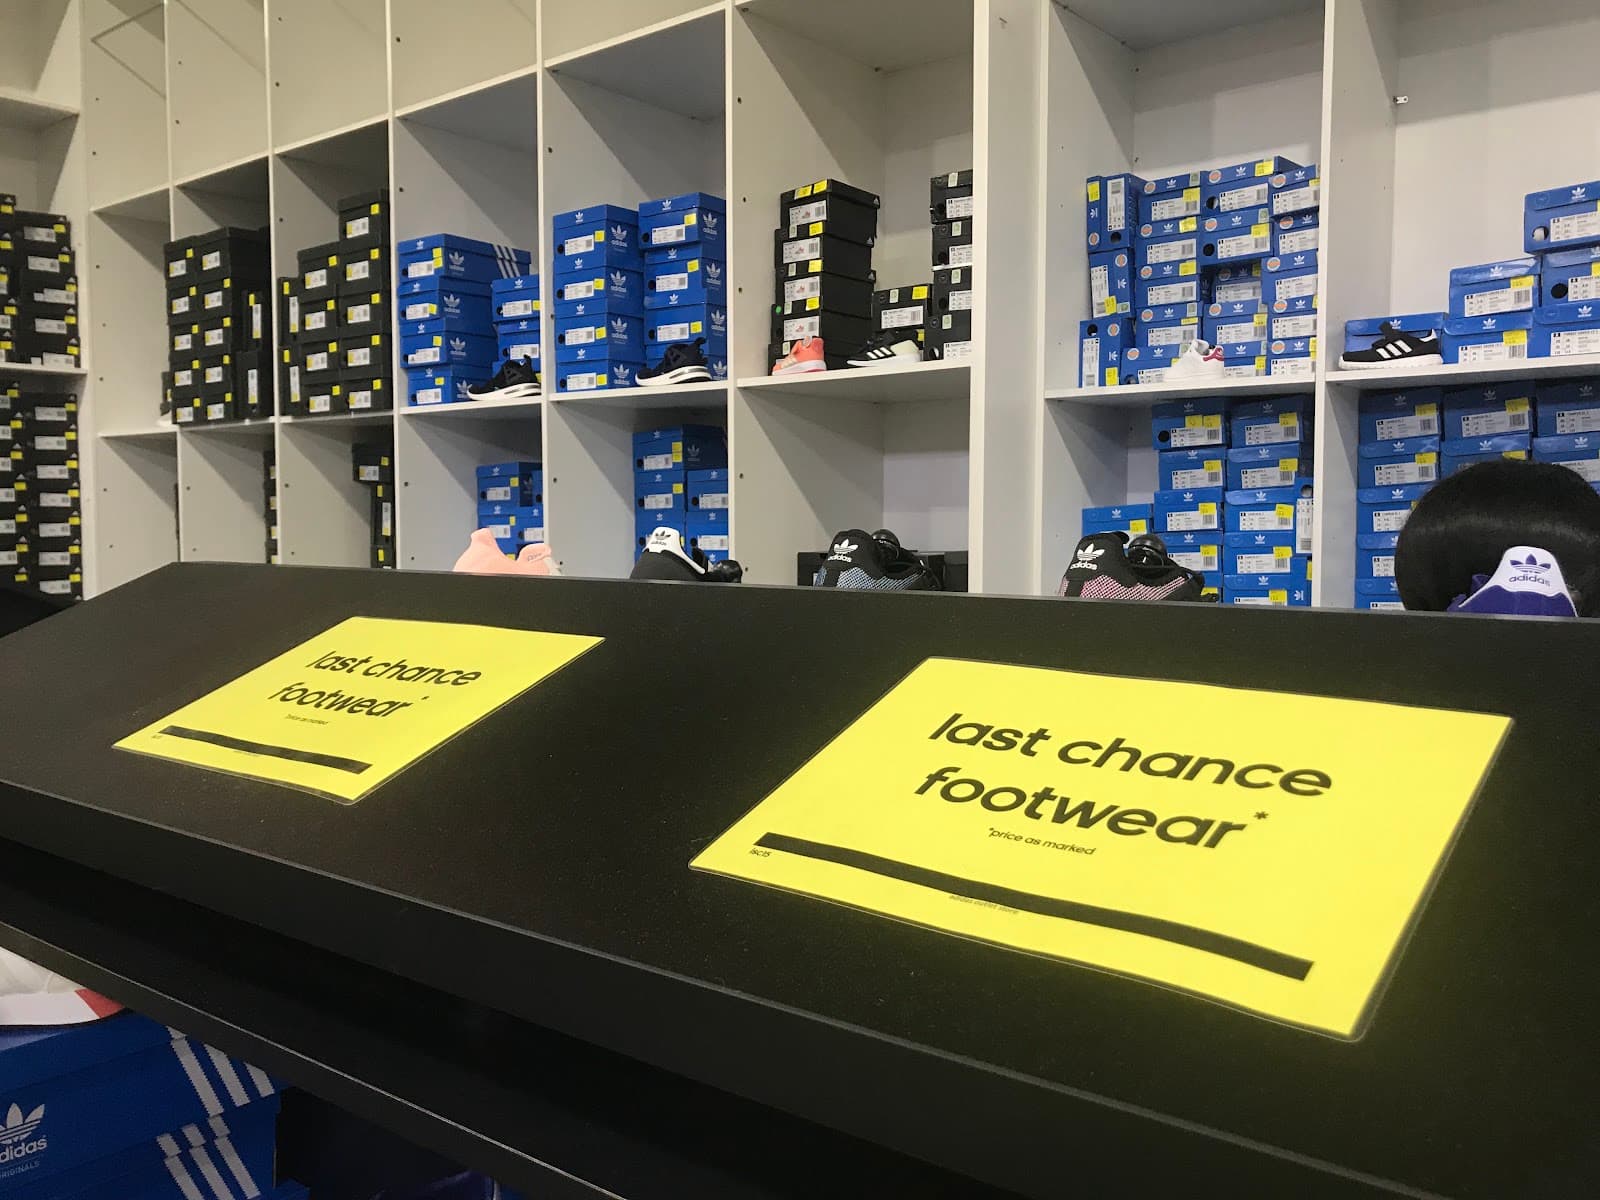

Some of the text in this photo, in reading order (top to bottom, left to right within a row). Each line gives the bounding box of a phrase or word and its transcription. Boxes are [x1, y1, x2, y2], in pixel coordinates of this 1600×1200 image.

[1069, 560, 1098, 571] adidas
[1508, 574, 1551, 587] adidas
[305, 650, 482, 686] last chance
[927, 712, 1333, 797] last chance
[1024, 836, 1042, 846] as
[1042, 839, 1098, 855] marked
[0, 1138, 48, 1164] didas
[0, 1160, 41, 1179] RIGINALS
